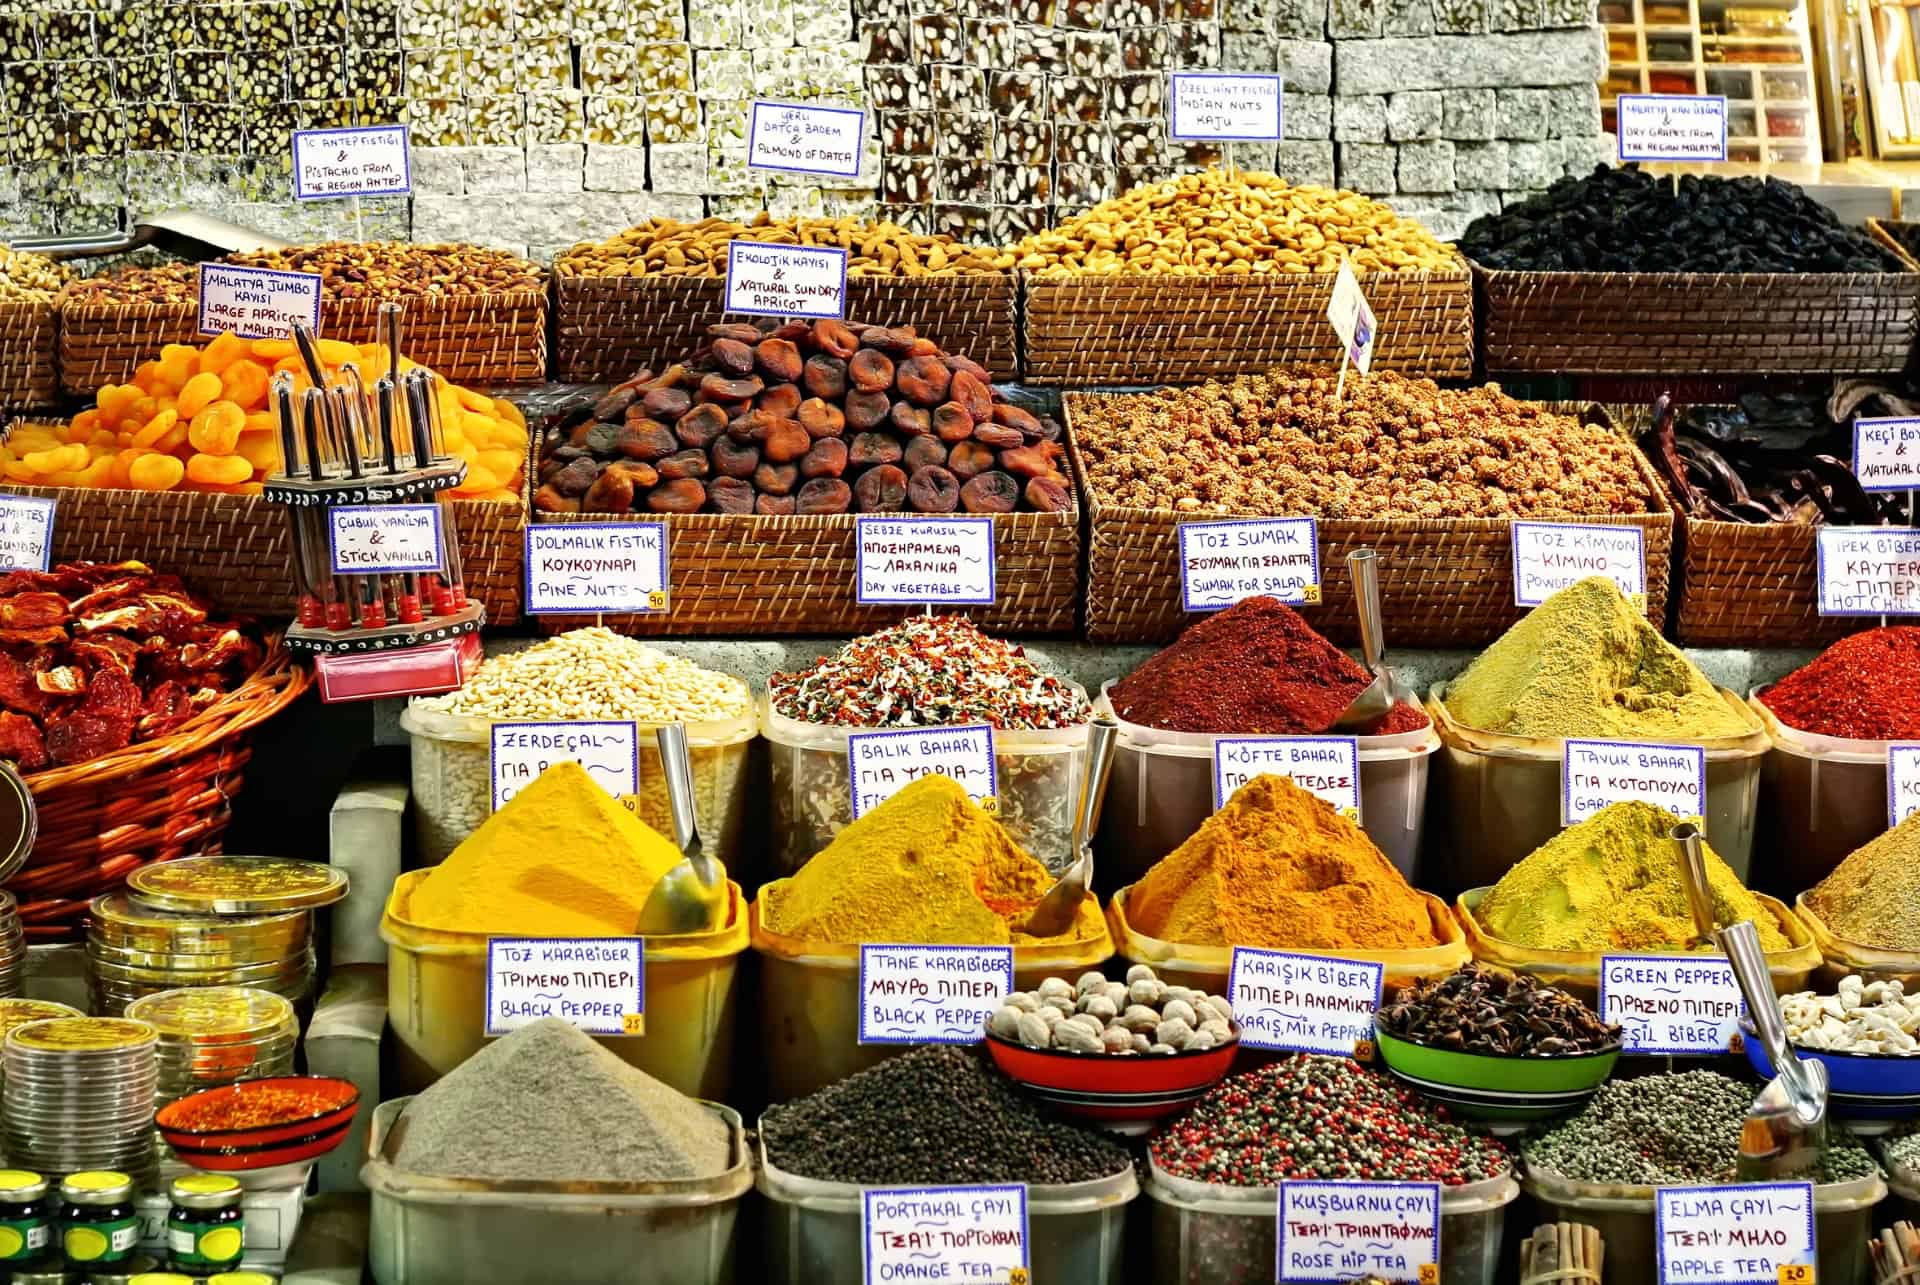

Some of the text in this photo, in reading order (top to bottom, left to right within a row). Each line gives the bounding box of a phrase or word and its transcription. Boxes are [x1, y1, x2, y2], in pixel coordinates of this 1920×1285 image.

[1230, 102, 1262, 110] NUTS
[1197, 115, 1231, 130] KAJU
[791, 135, 802, 144] &
[337, 150, 348, 161] &
[759, 143, 801, 159] ALMOND
[806, 150, 816, 160] OF
[363, 164, 392, 174] FROM
[304, 175, 401, 191] THE REGION ANTEP
[774, 268, 785, 280] &
[208, 274, 310, 294] MALATYA JUMBO
[736, 280, 789, 294] NATURAL
[235, 291, 271, 304] KAYISI
[208, 302, 246, 317] LARGE
[208, 318, 237, 331] FROM
[1896, 442, 1907, 455] &
[1862, 463, 1913, 477] NATURAL
[370, 530, 385, 544] &
[865, 525, 956, 536] SEBZE KURUSU
[536, 536, 604, 550] DOLMALIK
[1194, 530, 1299, 548] TOZ SUMAK
[1528, 532, 1565, 547] TOZ
[538, 582, 627, 596] PINE NUTS
[865, 582, 960, 594] DRY VEGETABLE
[1192, 576, 1306, 593] SUMAK FOR SALAD
[649, 596, 663, 607] 90
[1304, 590, 1317, 600] 25
[1833, 594, 1867, 610] HOT
[502, 733, 603, 752] ZERDEÇAL
[861, 739, 979, 759] BALIK BAHARI
[1290, 749, 1344, 765] BAHARI
[1576, 750, 1692, 772] TAVUK BAHARI
[983, 802, 996, 812] 40
[498, 948, 533, 962] TOZ
[872, 955, 919, 969] TANE
[1243, 959, 1312, 985] KARIŞIK
[1610, 967, 1734, 987] GREEN PEPPER
[501, 1000, 624, 1017] BLACK PEPPER
[874, 1006, 926, 1024] BLACK
[876, 1199, 1012, 1222] PORTAKAL ÇAYI
[1292, 1194, 1431, 1219] KUŞBURNU ÇAYI
[1671, 1199, 1772, 1221] ELMA ÇAYI
[1292, 1252, 1334, 1268] ROSE
[1372, 1255, 1406, 1270] TEA
[1672, 1257, 1772, 1276] APPLE TEA
[880, 1263, 992, 1280] ORANGE TEA
